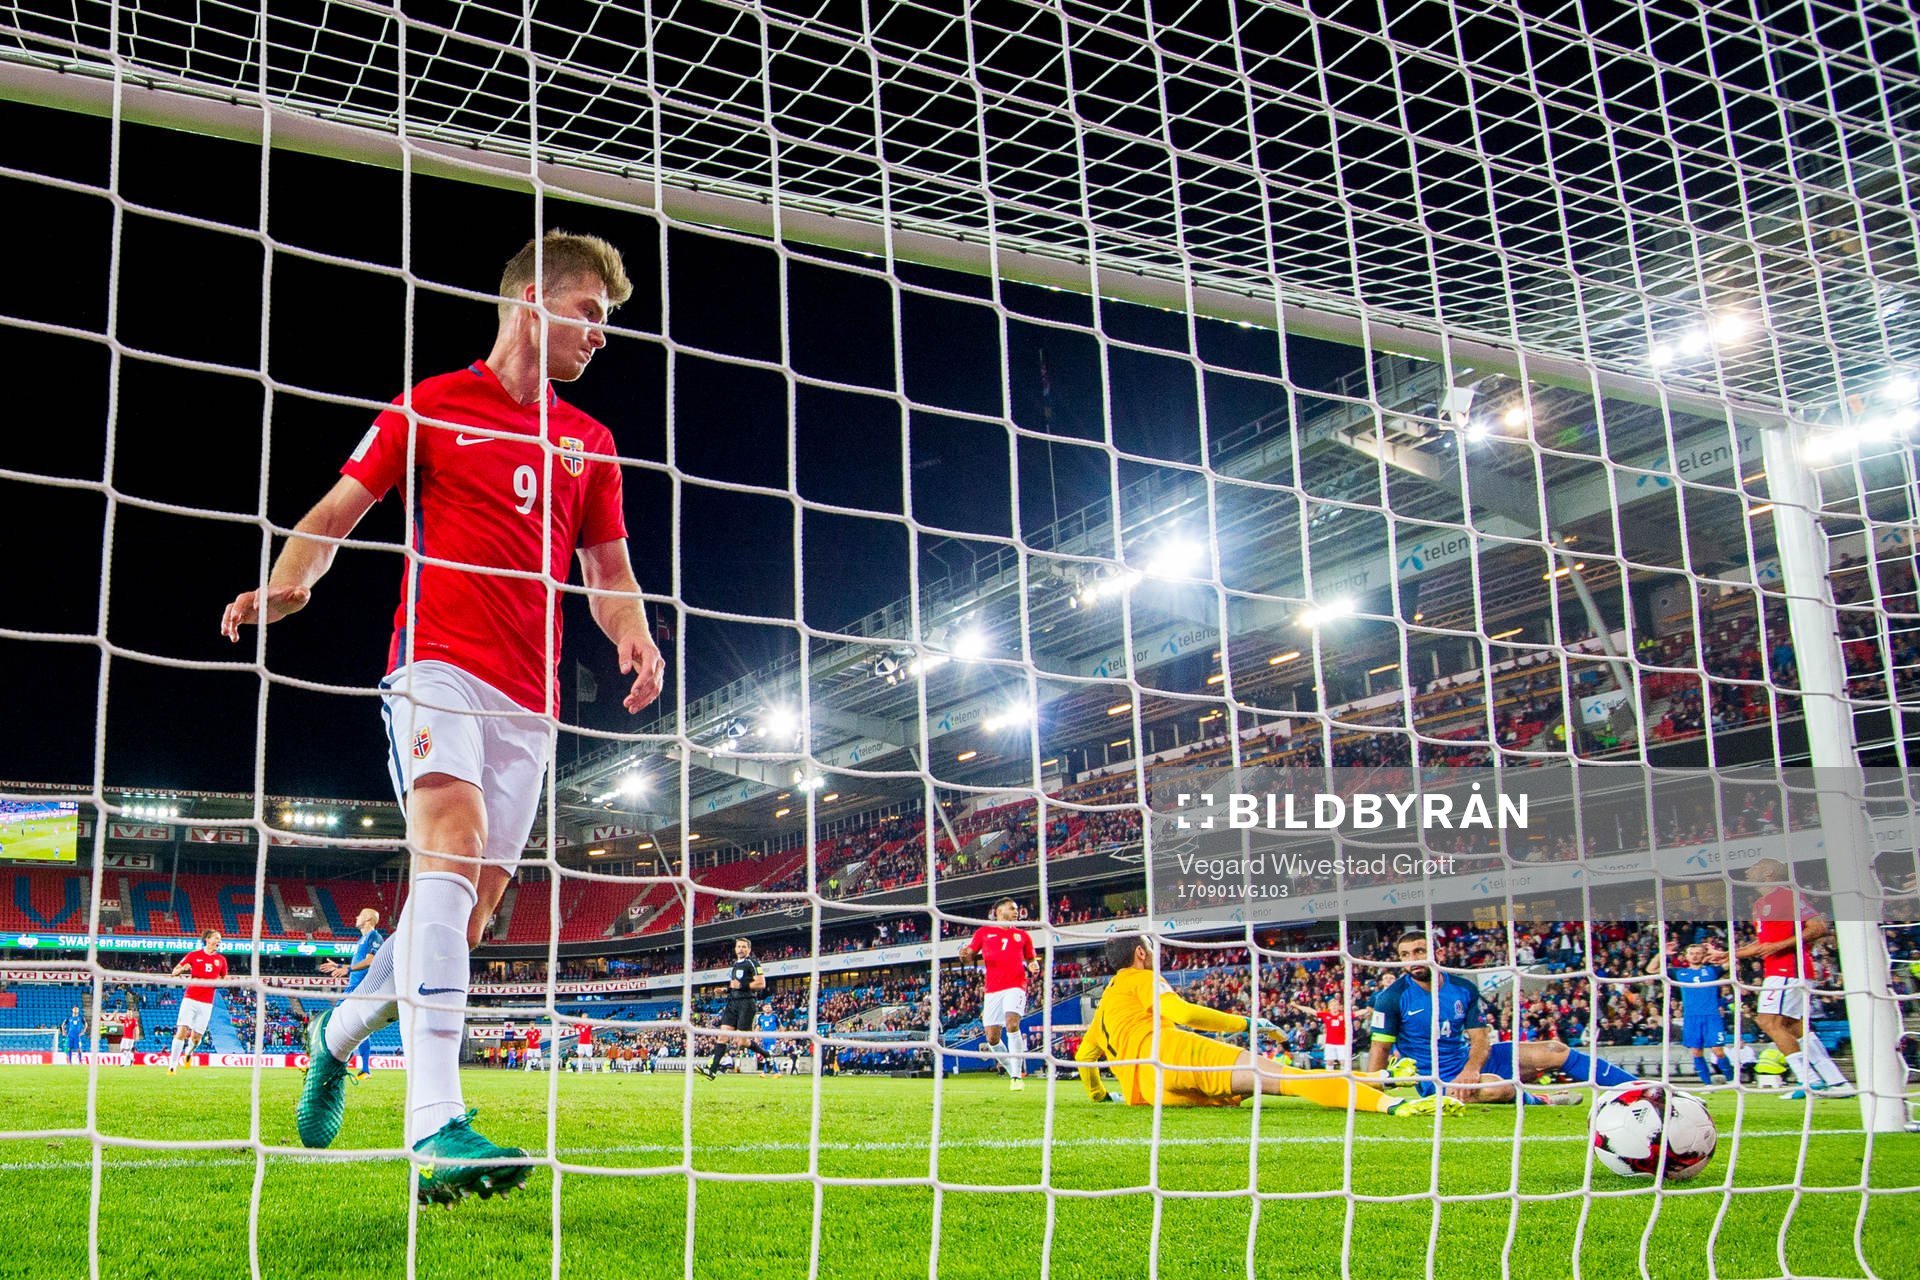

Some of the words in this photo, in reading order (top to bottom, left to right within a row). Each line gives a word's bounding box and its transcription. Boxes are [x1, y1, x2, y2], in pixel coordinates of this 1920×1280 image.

[1679, 437, 1752, 473] elenr
[513, 464, 537, 515] 9
[1178, 628, 1218, 648] teleno
[951, 708, 981, 727] telenor
[115, 825, 167, 839] VG
[192, 828, 242, 842] VG
[103, 853, 149, 866] VG
[1708, 846, 1762, 863] teenor
[1489, 875, 1532, 889] telnor
[1397, 888, 1436, 900] telenr
[1315, 899, 1350, 911] telenr
[58, 936, 91, 946] SWAP
[99, 939, 112, 947] en
[115, 939, 164, 948] smartere
[166, 938, 194, 949] måte
[334, 944, 358, 953] SWA
[1001, 938, 1008, 951] 7
[43, 973, 72, 981] VG
[580, 983, 604, 992] VG
[606, 982, 628, 991] VG
[629, 981, 647, 989] VG
[1767, 990, 1775, 1000] 2
[0, 1054, 42, 1064] anon
[222, 1055, 273, 1066] Cann
